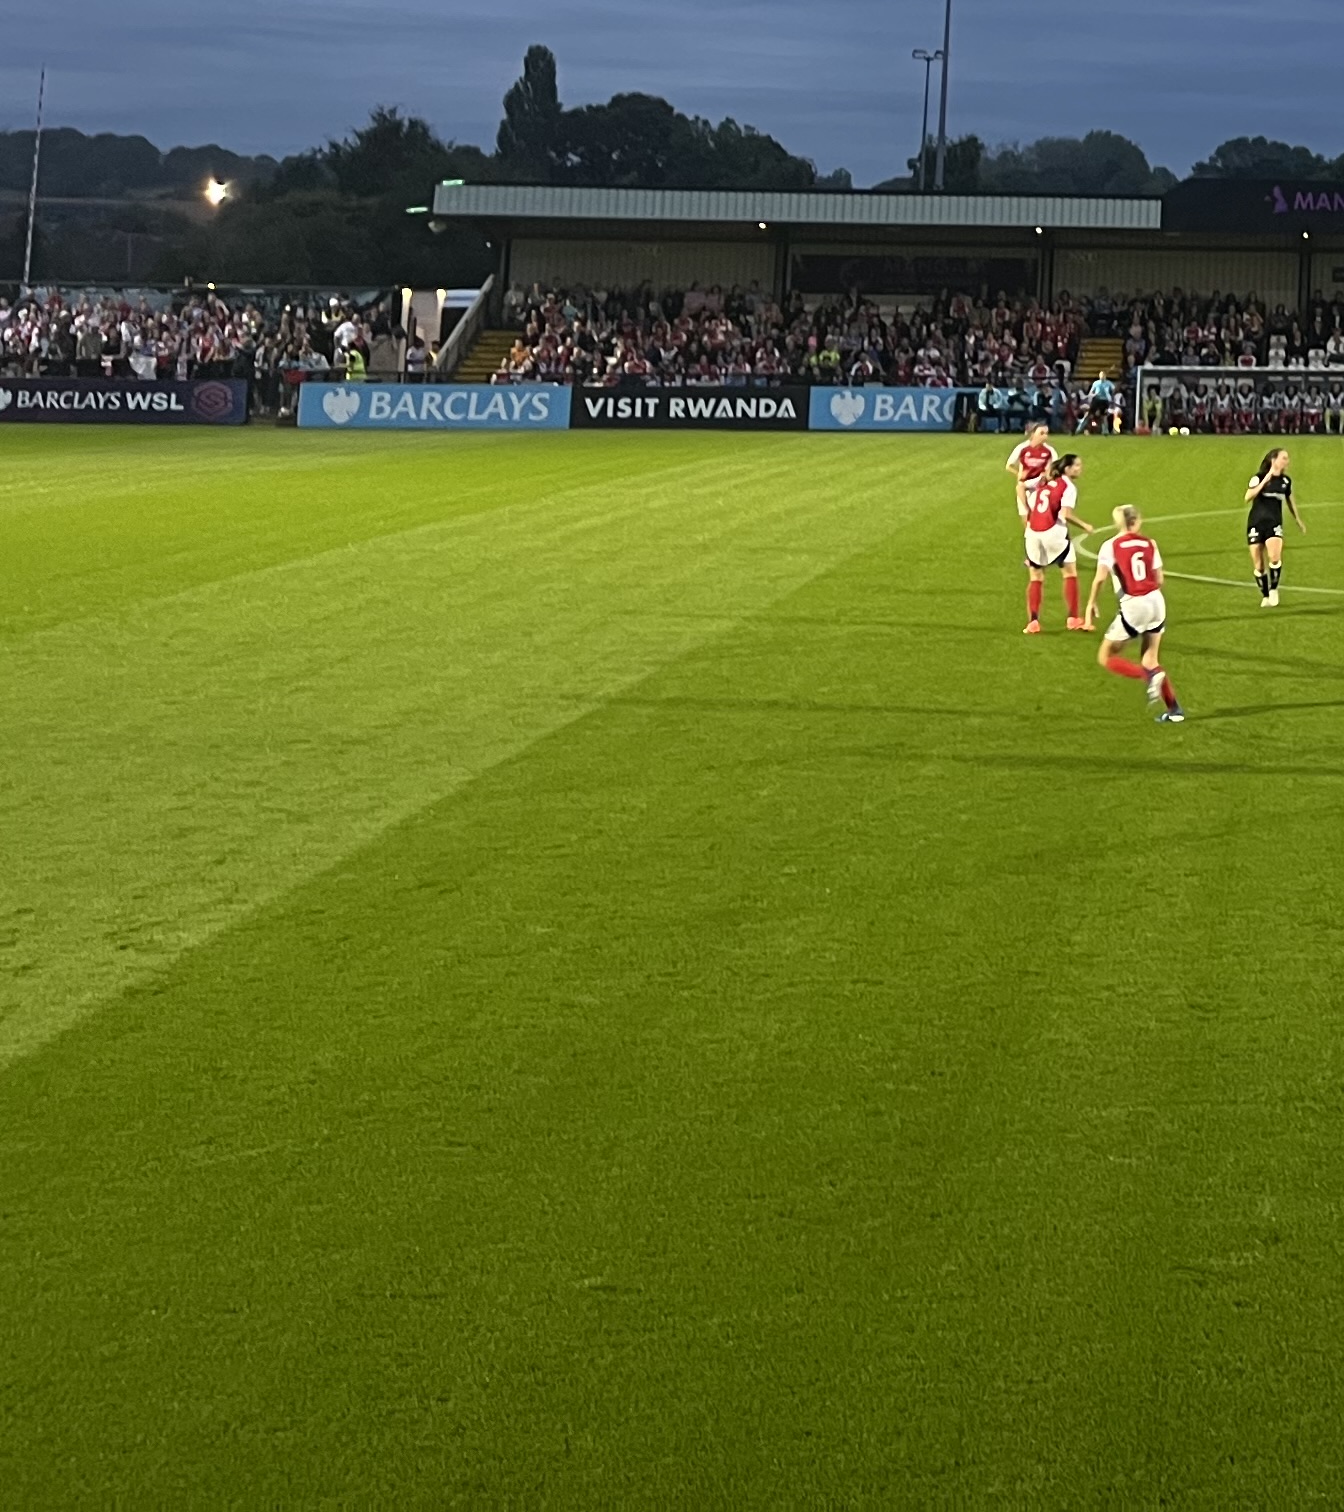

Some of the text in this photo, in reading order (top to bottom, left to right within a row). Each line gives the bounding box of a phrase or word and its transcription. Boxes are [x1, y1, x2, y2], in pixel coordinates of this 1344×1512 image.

[16, 390, 184, 410] BARCLAYS WSL
[369, 391, 550, 421] BARCLAYS
[584, 398, 797, 419] VISIT RWANDA
[1130, 551, 1147, 581] 6
